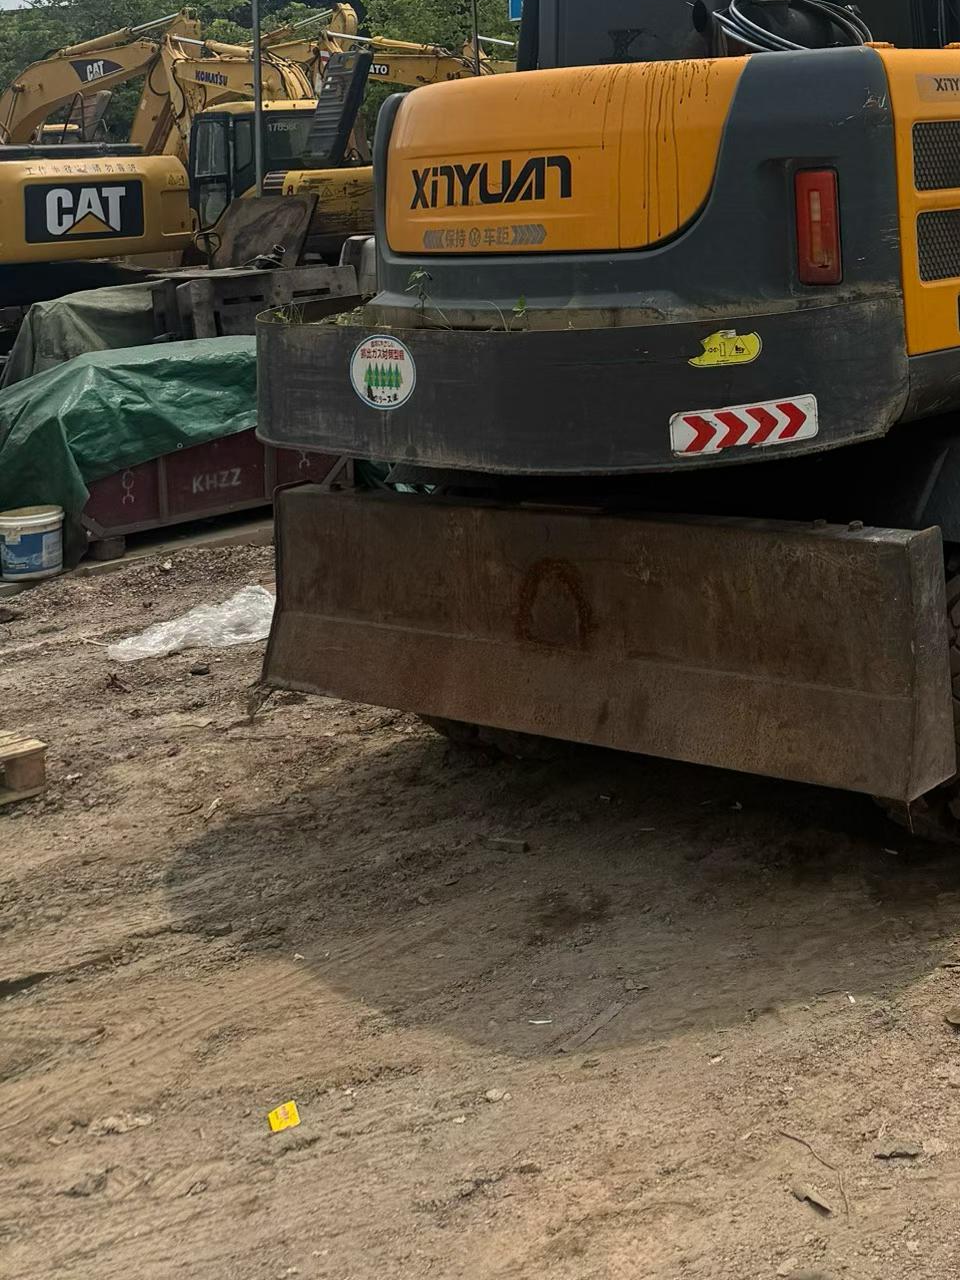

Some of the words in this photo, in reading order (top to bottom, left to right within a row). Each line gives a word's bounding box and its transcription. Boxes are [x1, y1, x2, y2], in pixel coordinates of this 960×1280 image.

[86, 60, 105, 81] CAT
[194, 70, 229, 87] KOMATSU
[366, 64, 388, 75] ATO
[46, 186, 126, 236] CAT
